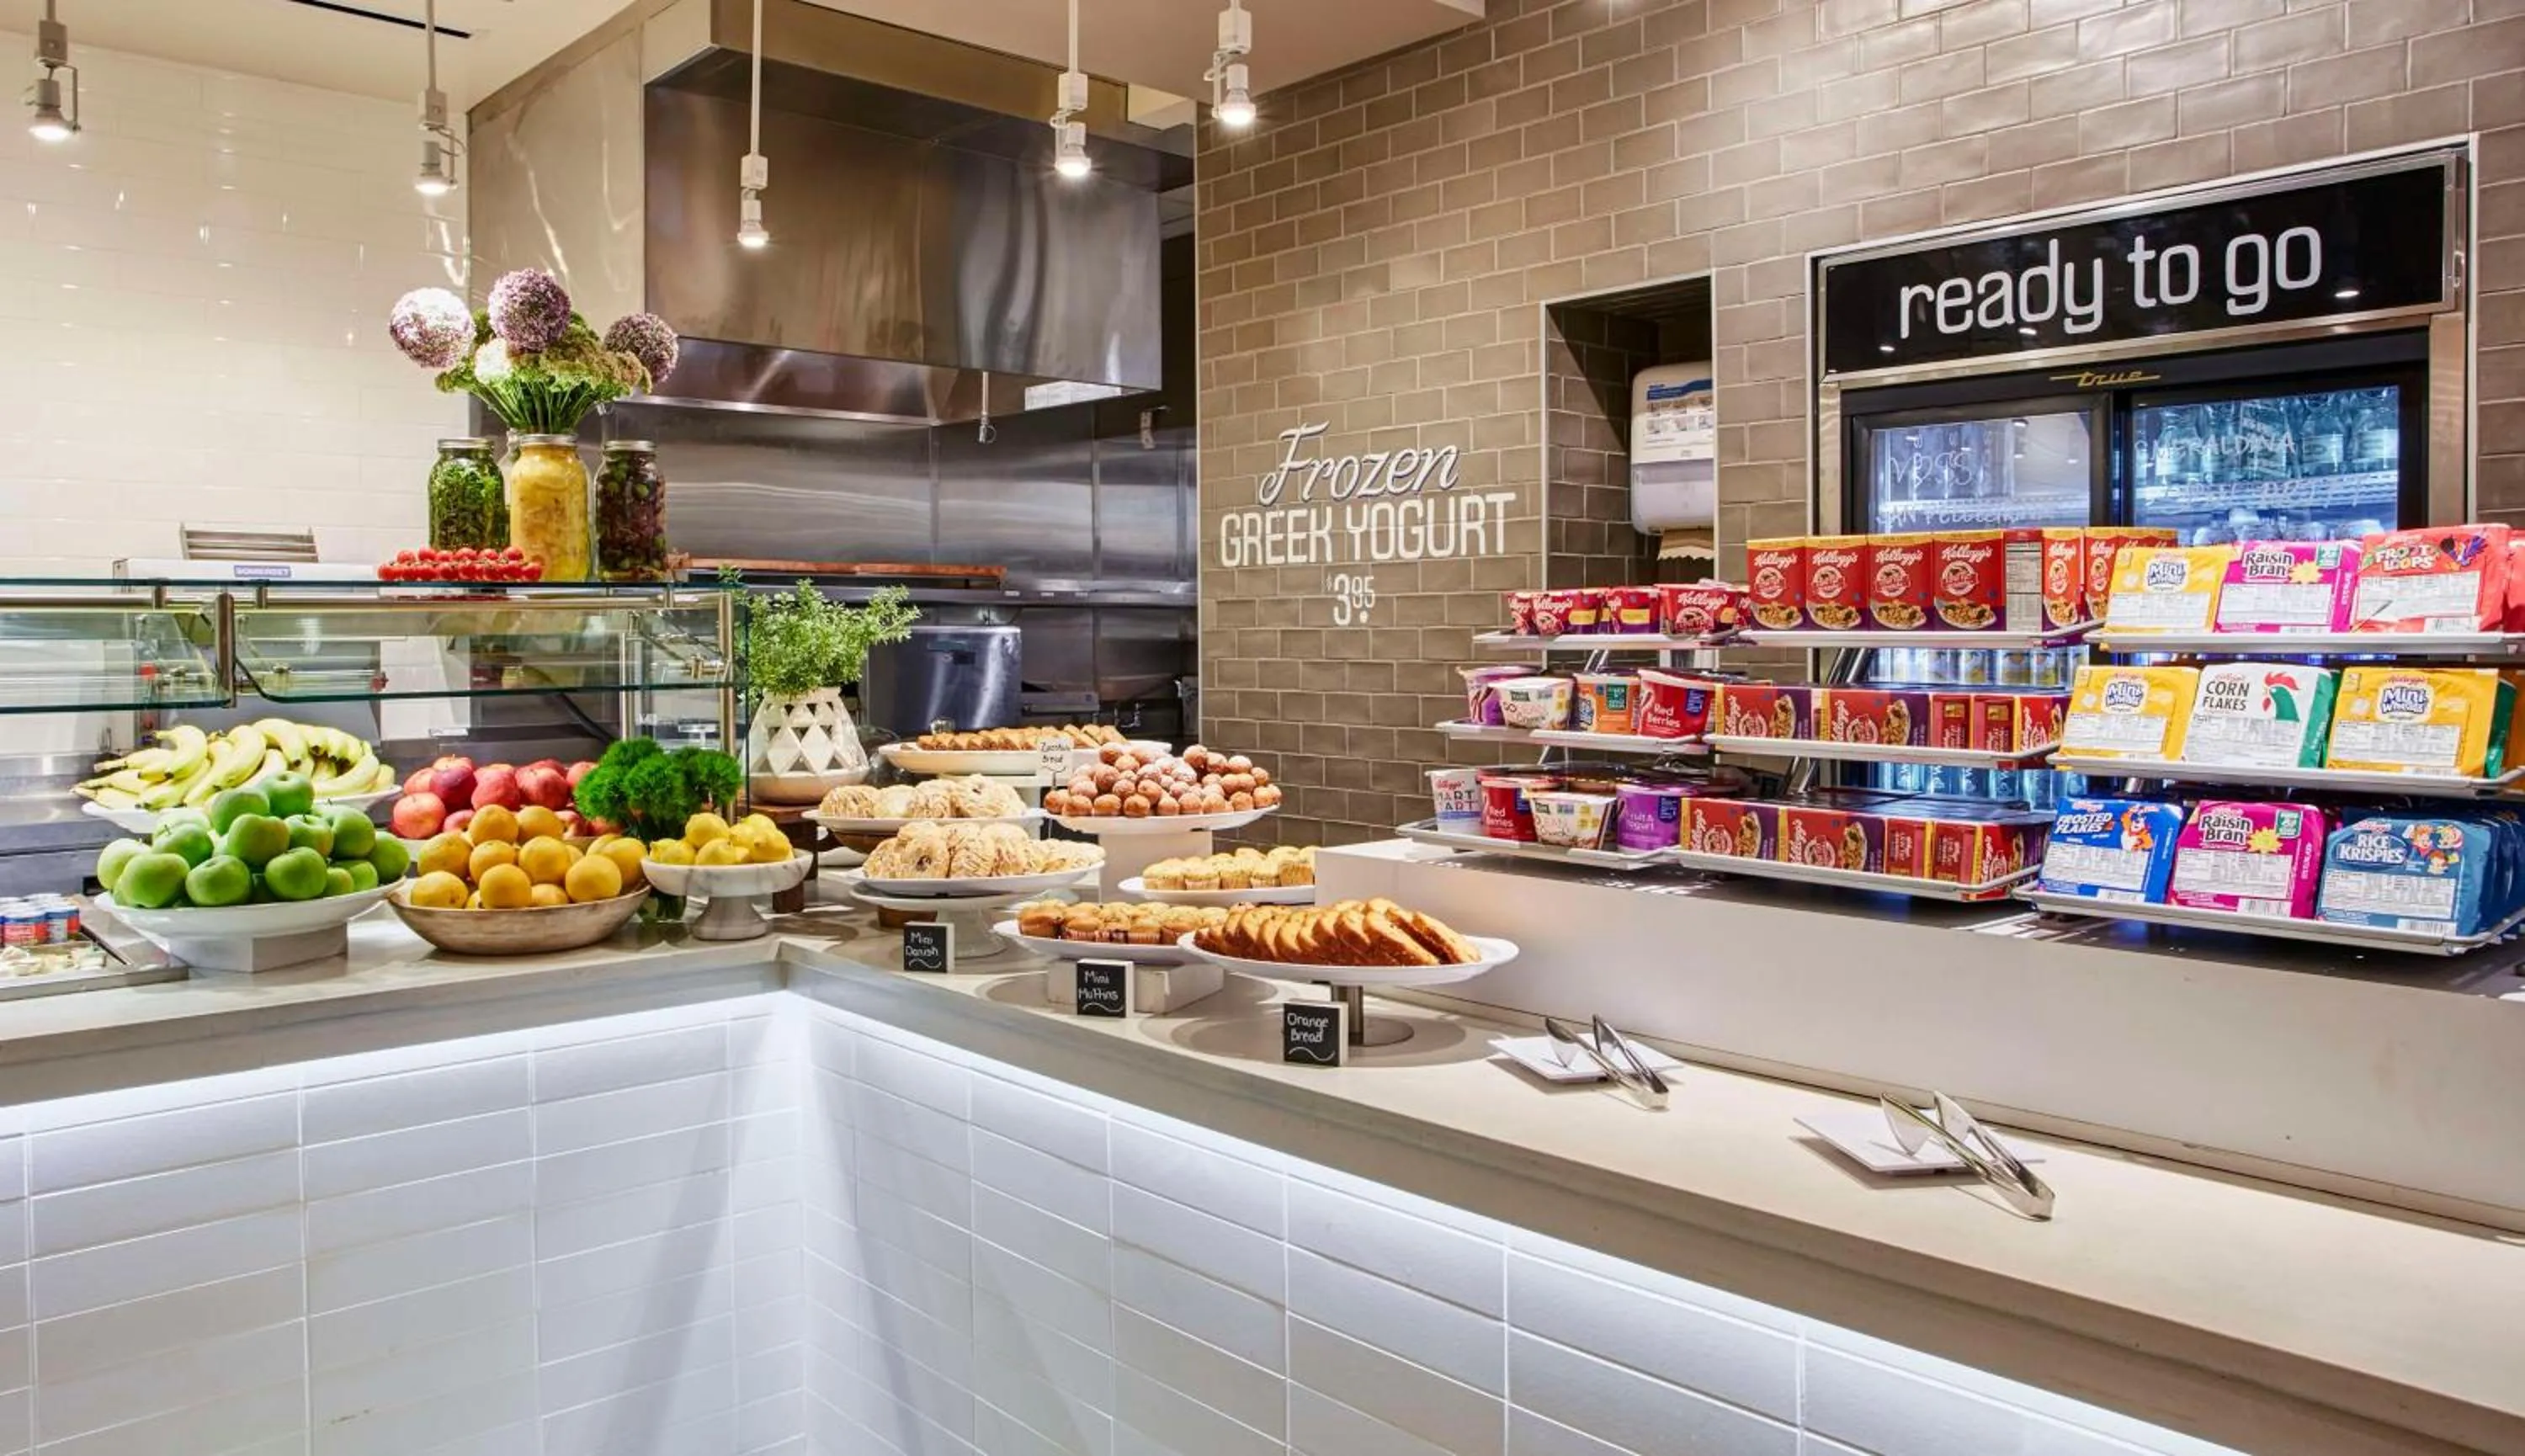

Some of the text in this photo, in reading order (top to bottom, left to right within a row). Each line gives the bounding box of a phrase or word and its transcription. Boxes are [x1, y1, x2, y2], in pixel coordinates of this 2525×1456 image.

[1900, 226, 2321, 338] ready to go
[2062, 371, 2156, 387] true
[1259, 422, 1459, 505] Frozen
[1220, 492, 1516, 567] GREEK YOGURT
[1754, 551, 1798, 568] Kellogg's
[1812, 550, 1858, 567] Kellogg's
[1875, 548, 1923, 566] Kellogg's
[1942, 544, 1993, 563] Kellogg's
[2245, 552, 2292, 566] Raisin
[2248, 564, 2286, 577] Bran
[1677, 591, 1729, 610] Kellogg's
[2206, 681, 2250, 697] CORN
[1655, 703, 1674, 716] Red
[2203, 696, 2246, 711] FLAKES
[1647, 712, 1681, 728] Berries
[1489, 805, 1506, 817] Red
[2057, 812, 2113, 826] FROSTED
[2054, 822, 2102, 834] FLAKES
[2201, 815, 2251, 831] Raisin
[2205, 827, 2245, 843] Bran
[2358, 834, 2389, 848] RICE
[2339, 843, 2405, 864] KRISPIES
[1287, 1012, 1330, 1030] Orange
